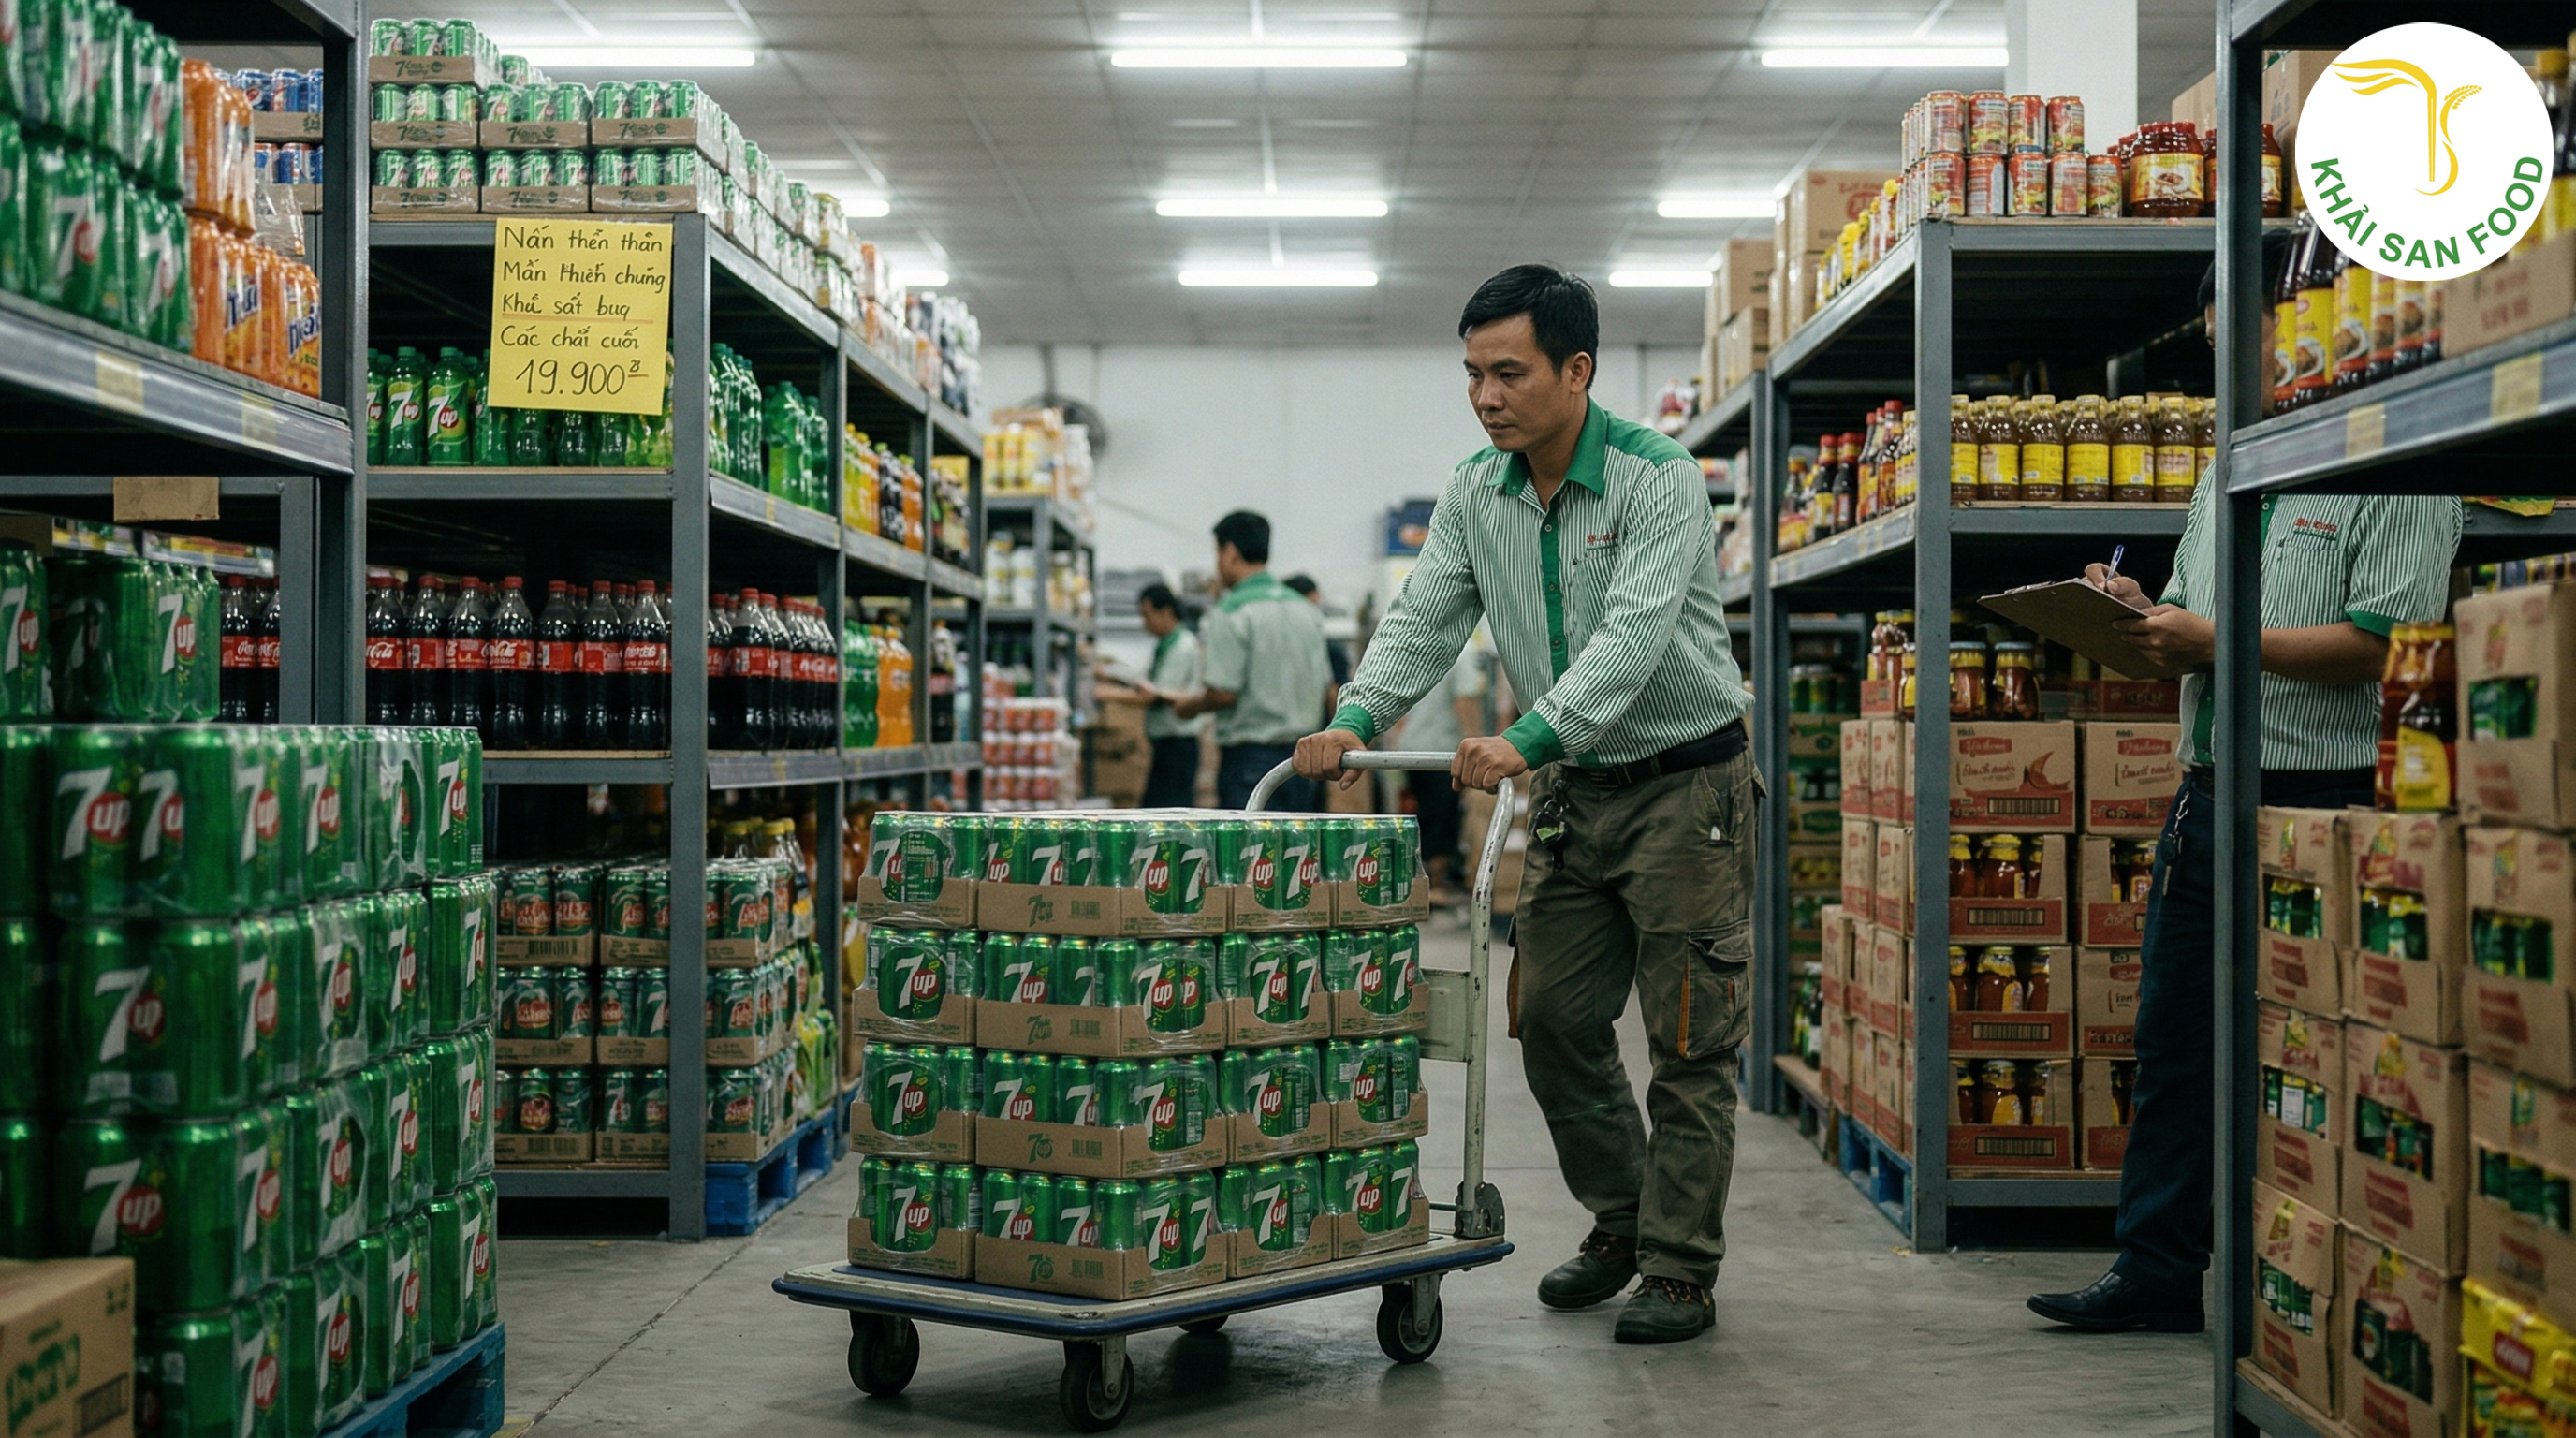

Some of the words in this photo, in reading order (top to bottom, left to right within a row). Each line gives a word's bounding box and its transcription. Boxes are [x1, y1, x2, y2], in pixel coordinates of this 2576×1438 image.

[515, 359, 626, 396] 19.900
[428, 394, 459, 438] 7up
[58, 765, 130, 861] 7up
[895, 953, 937, 1009] 7up
[887, 1070, 924, 1126] 7up
[993, 1078, 1033, 1121] 7up
[1247, 1071, 1281, 1127] 7up
[892, 1186, 930, 1243] 7up
[992, 1198, 1033, 1240] 7up
[1143, 1203, 1179, 1263] 7up
